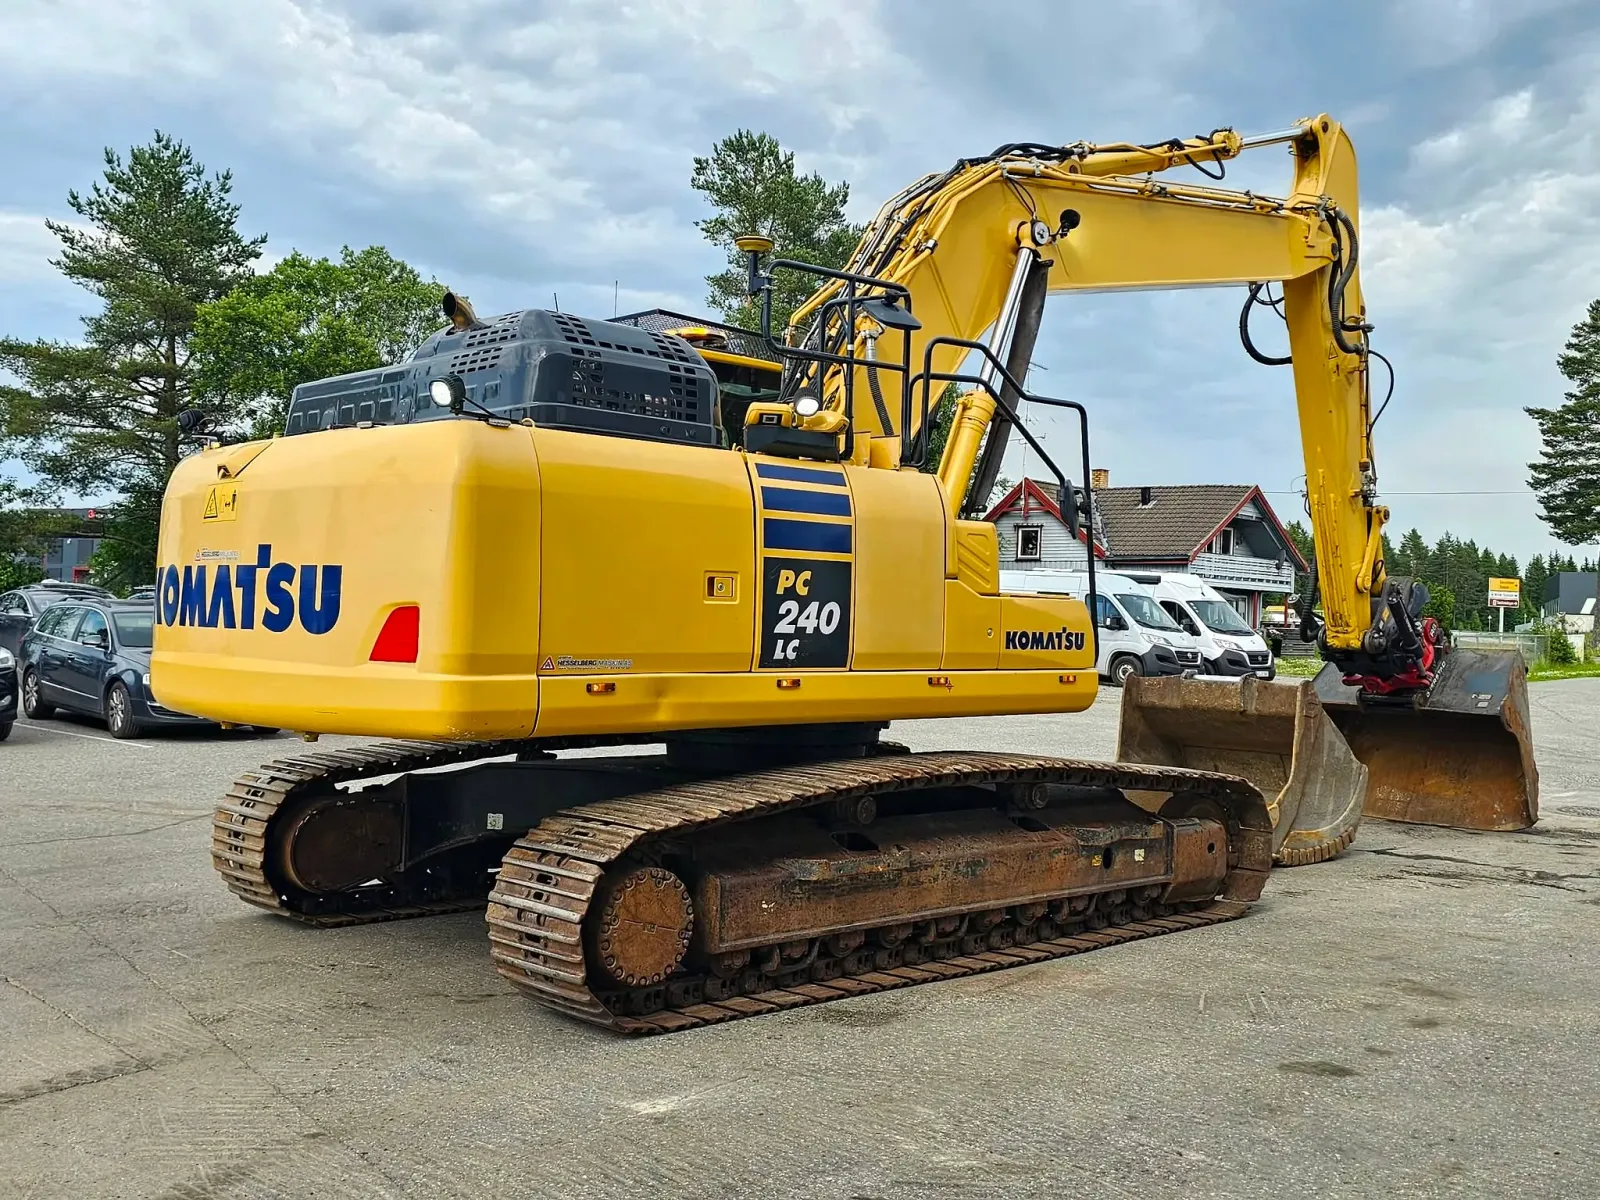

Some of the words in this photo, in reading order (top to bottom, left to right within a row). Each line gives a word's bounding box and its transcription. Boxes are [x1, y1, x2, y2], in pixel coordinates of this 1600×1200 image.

[776, 569, 812, 596] PC
[773, 600, 841, 635] 240
[773, 639, 800, 660] LC
[1005, 626, 1085, 650] KOMATSU
